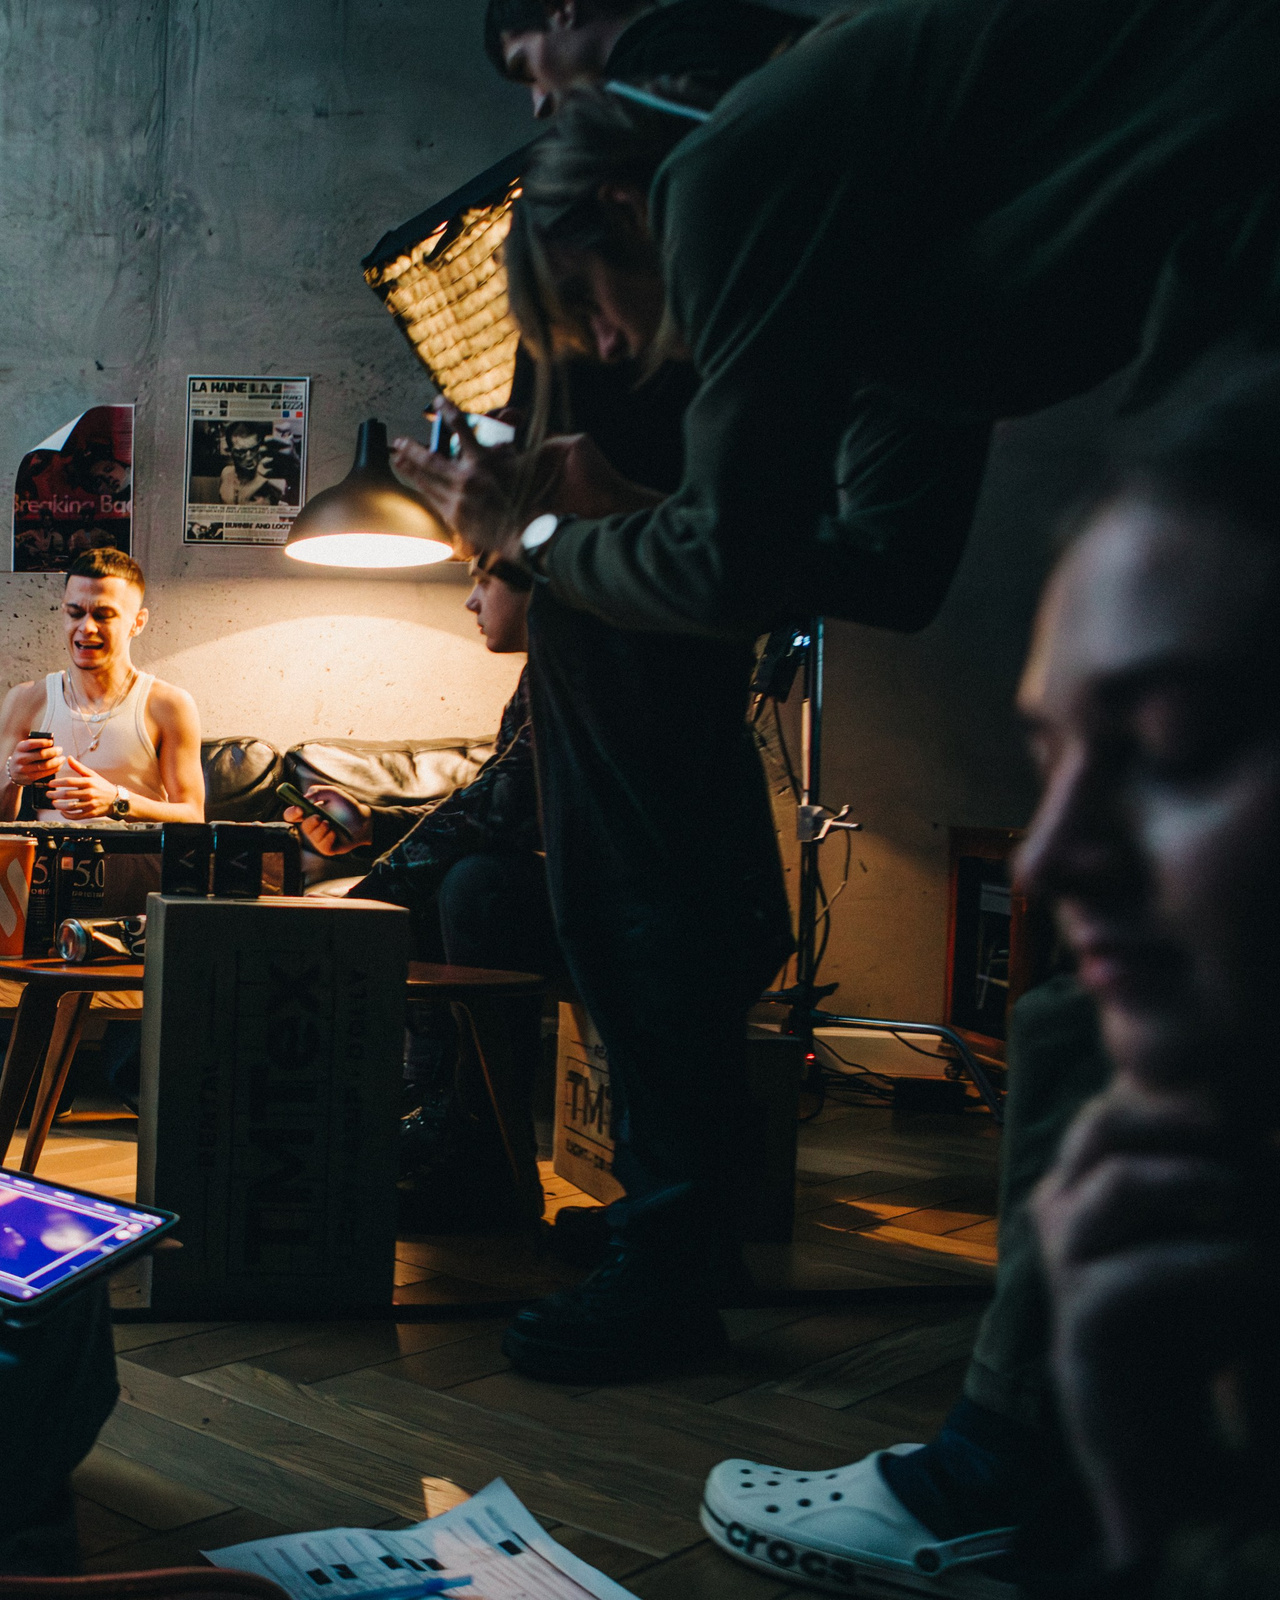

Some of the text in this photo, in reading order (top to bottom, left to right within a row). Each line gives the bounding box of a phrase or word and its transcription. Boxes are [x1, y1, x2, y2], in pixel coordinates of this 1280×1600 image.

[192, 382, 207, 393] LA
[211, 382, 248, 393] HAINE
[243, 961, 322, 1266] TMTex
[566, 1070, 610, 1135] TM
[726, 1520, 856, 1586] crocs
